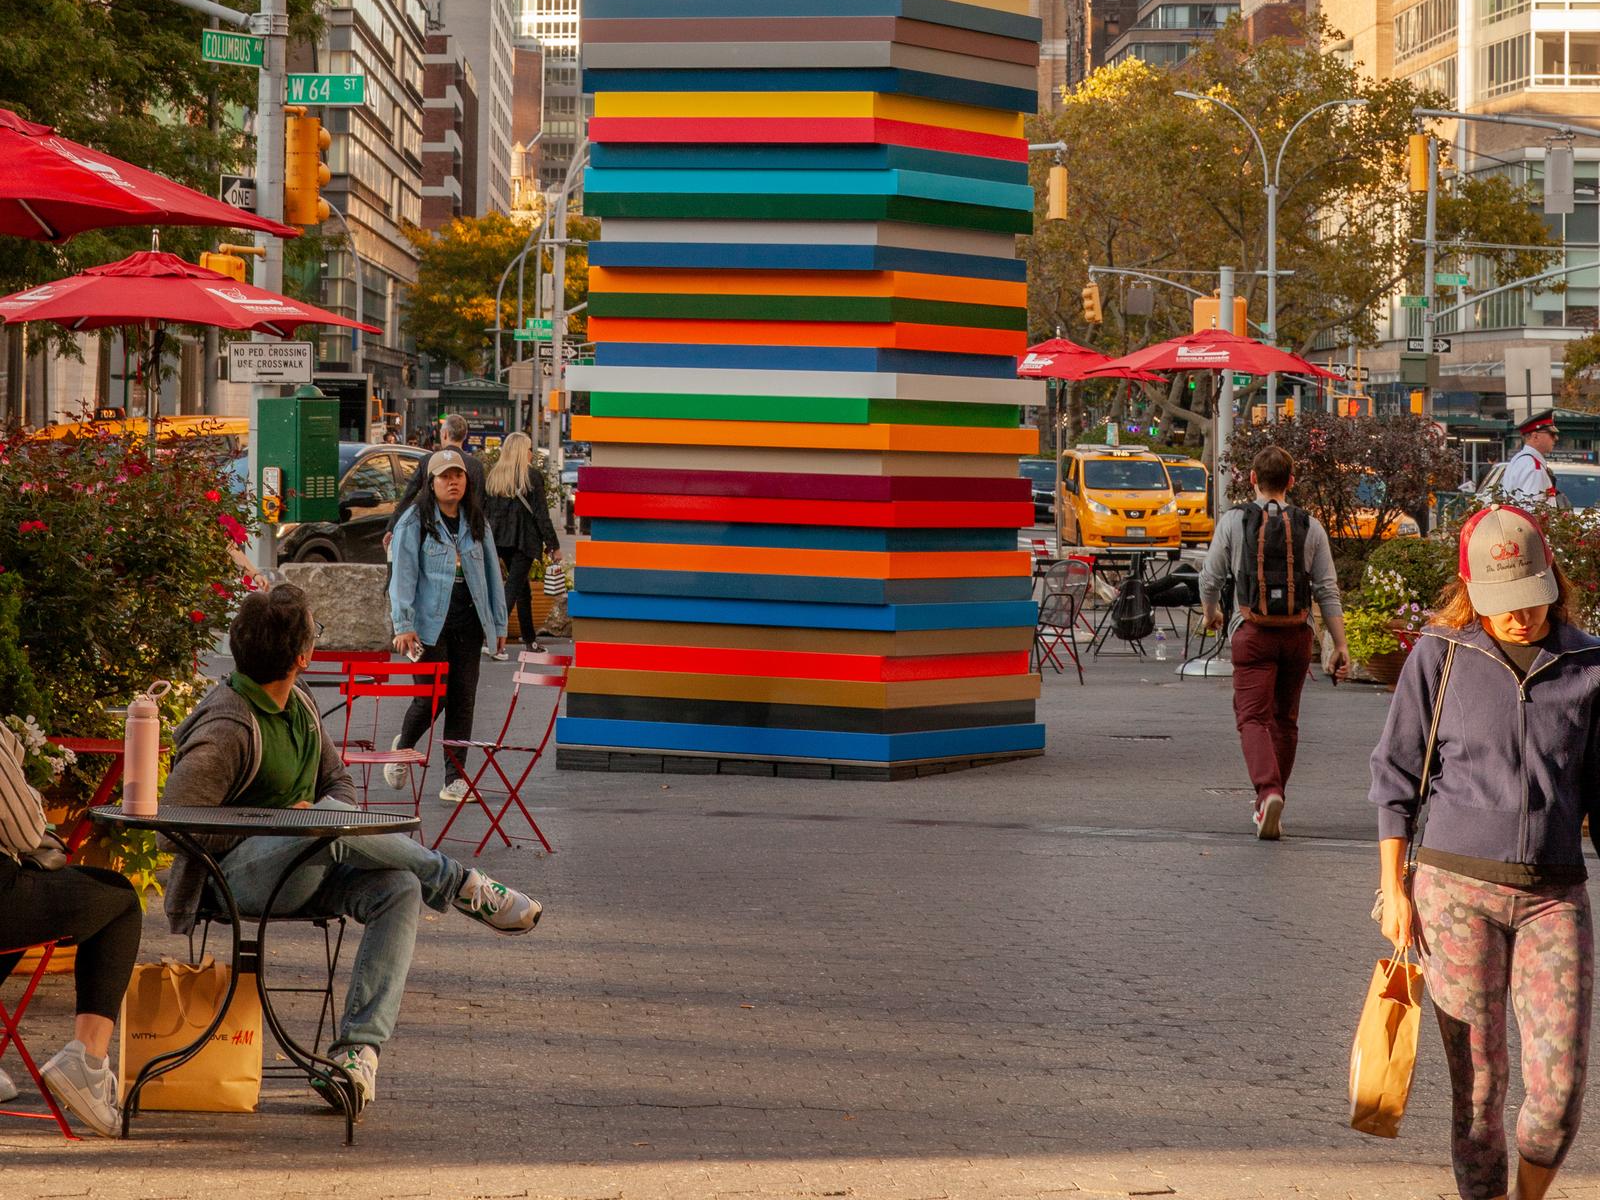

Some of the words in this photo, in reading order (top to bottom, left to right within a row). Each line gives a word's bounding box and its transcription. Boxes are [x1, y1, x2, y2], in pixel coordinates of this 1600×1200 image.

[205, 33, 251, 62] COLUMBUS
[291, 78, 305, 100] W
[308, 78, 331, 101] 64
[343, 78, 357, 91] ST
[231, 189, 250, 206] ONE
[233, 348, 245, 357] NO
[268, 348, 307, 357] CROSSING
[237, 360, 253, 368] USE
[257, 360, 303, 368] CROSSWALK
